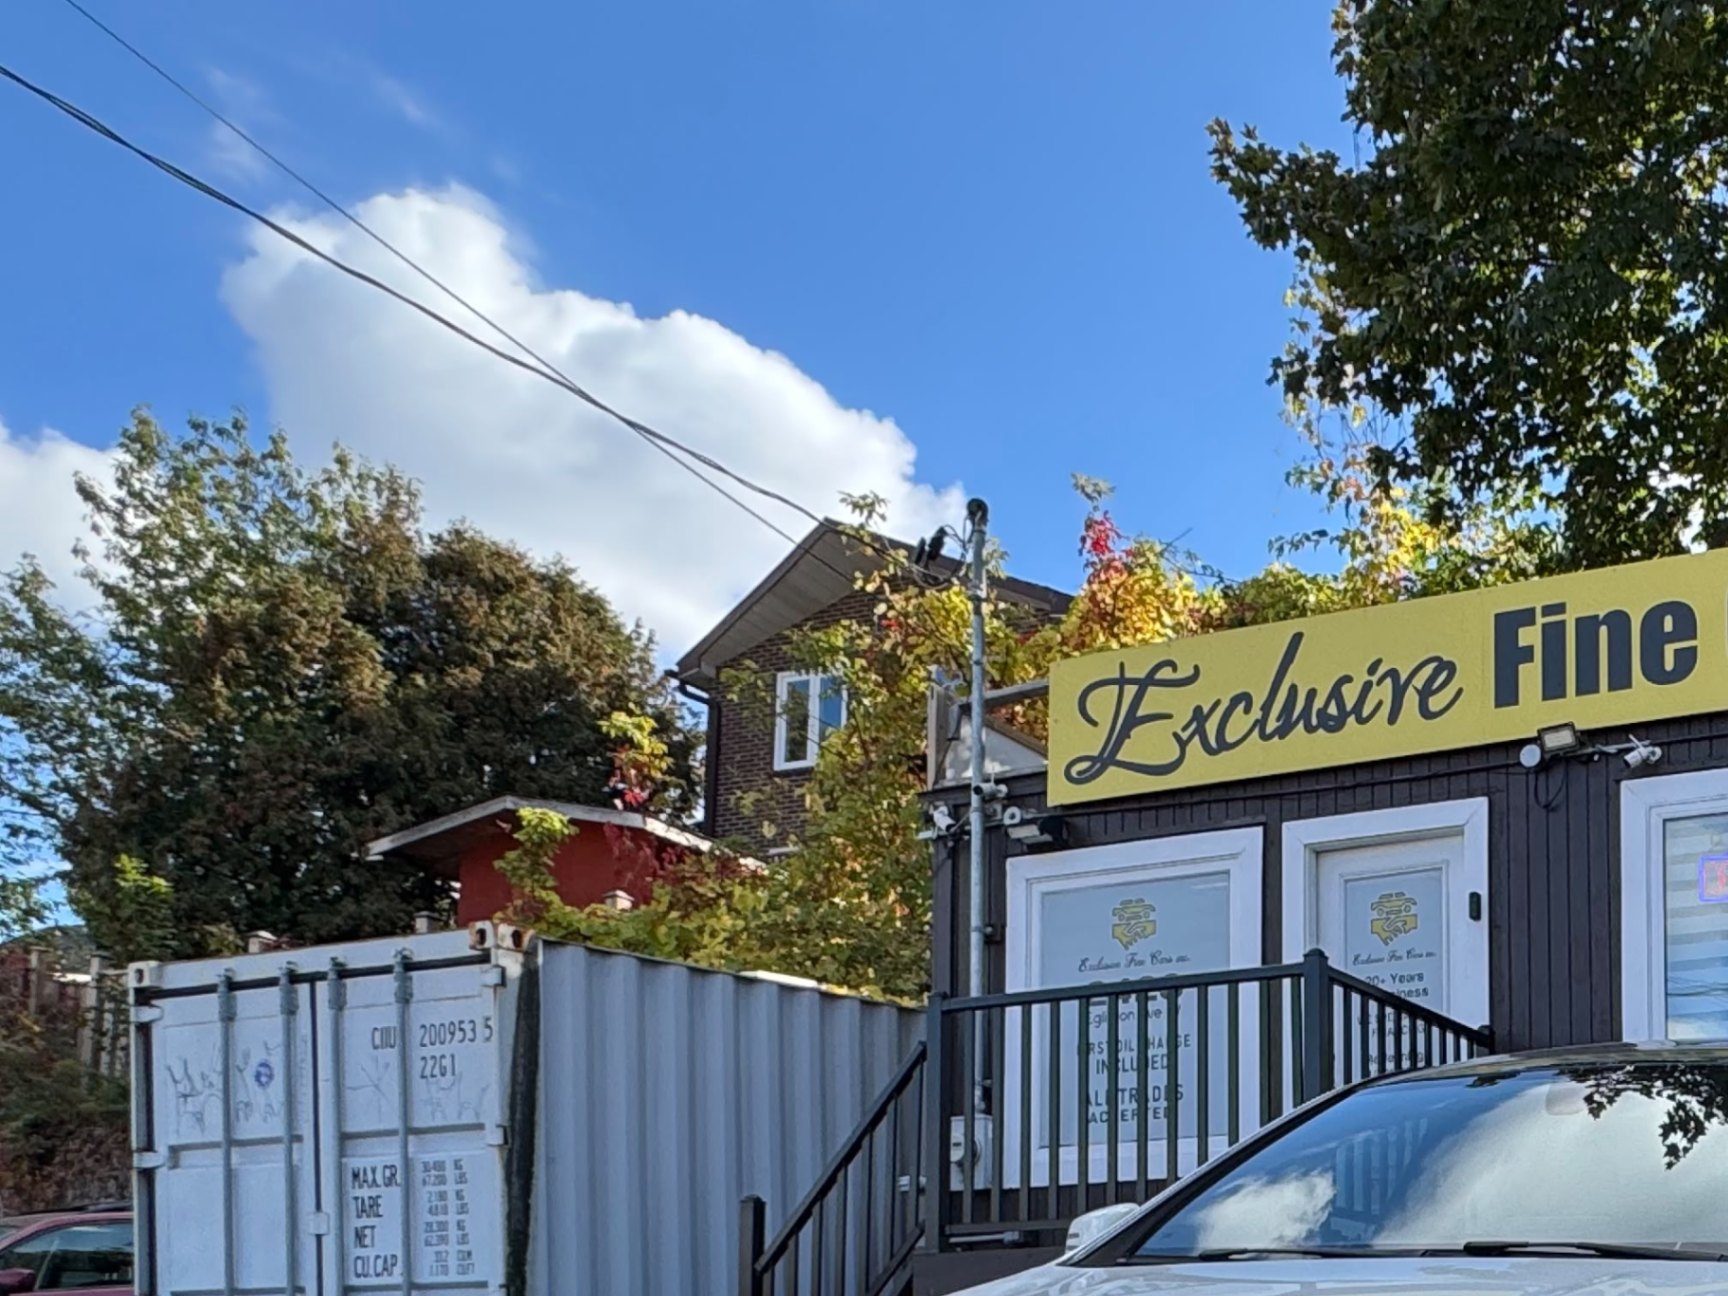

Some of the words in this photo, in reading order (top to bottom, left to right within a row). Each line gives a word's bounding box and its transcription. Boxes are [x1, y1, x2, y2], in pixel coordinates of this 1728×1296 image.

[1064, 631, 1464, 786] Exclusive
[1492, 600, 1698, 709] Fine
[1390, 972, 1424, 985] Years
[419, 1019, 477, 1048] 200953
[482, 1015, 494, 1043] 5
[419, 1053, 456, 1079] 22G1
[1096, 1053, 1170, 1076] INLUED
[1117, 1083, 1184, 1106] TRDS
[1087, 1105, 1172, 1125] ACEPE
[351, 1195, 384, 1219] TARE
[354, 1224, 376, 1249] NET
